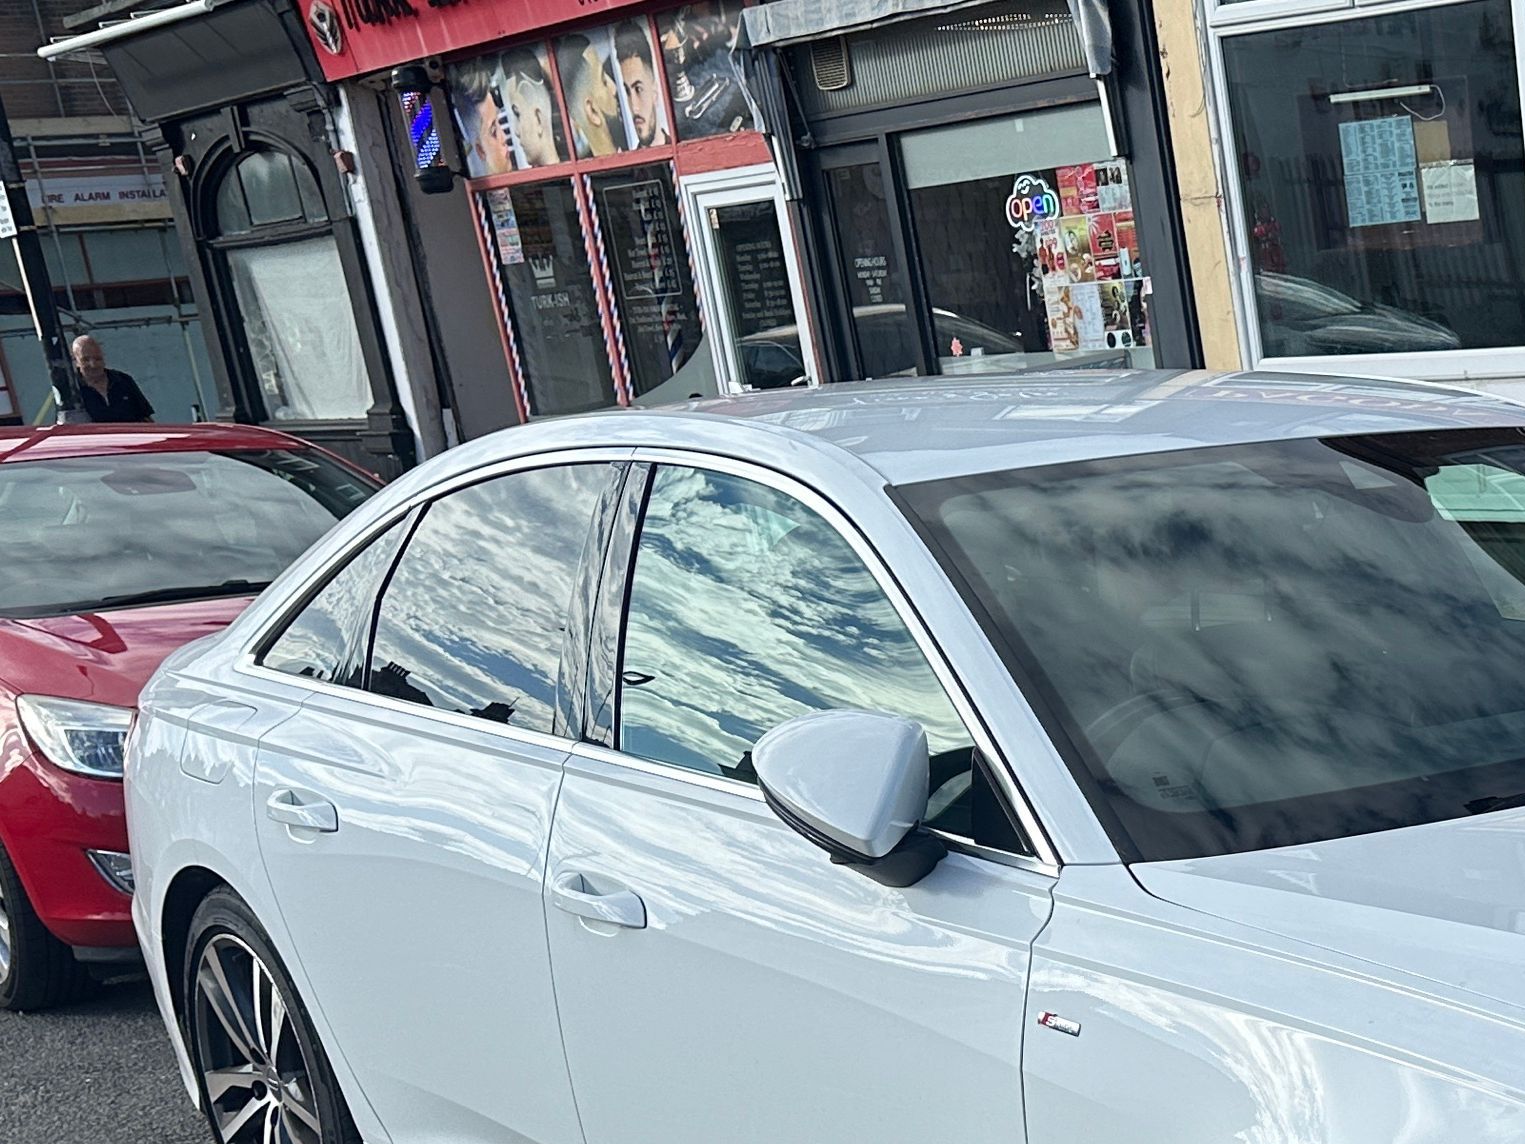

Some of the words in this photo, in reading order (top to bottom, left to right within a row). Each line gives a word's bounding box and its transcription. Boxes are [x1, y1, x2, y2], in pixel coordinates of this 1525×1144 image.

[42, 194, 64, 203] IRE
[74, 191, 111, 202] ALARM
[1011, 194, 1055, 219] open
[530, 292, 571, 309] TURKISH
